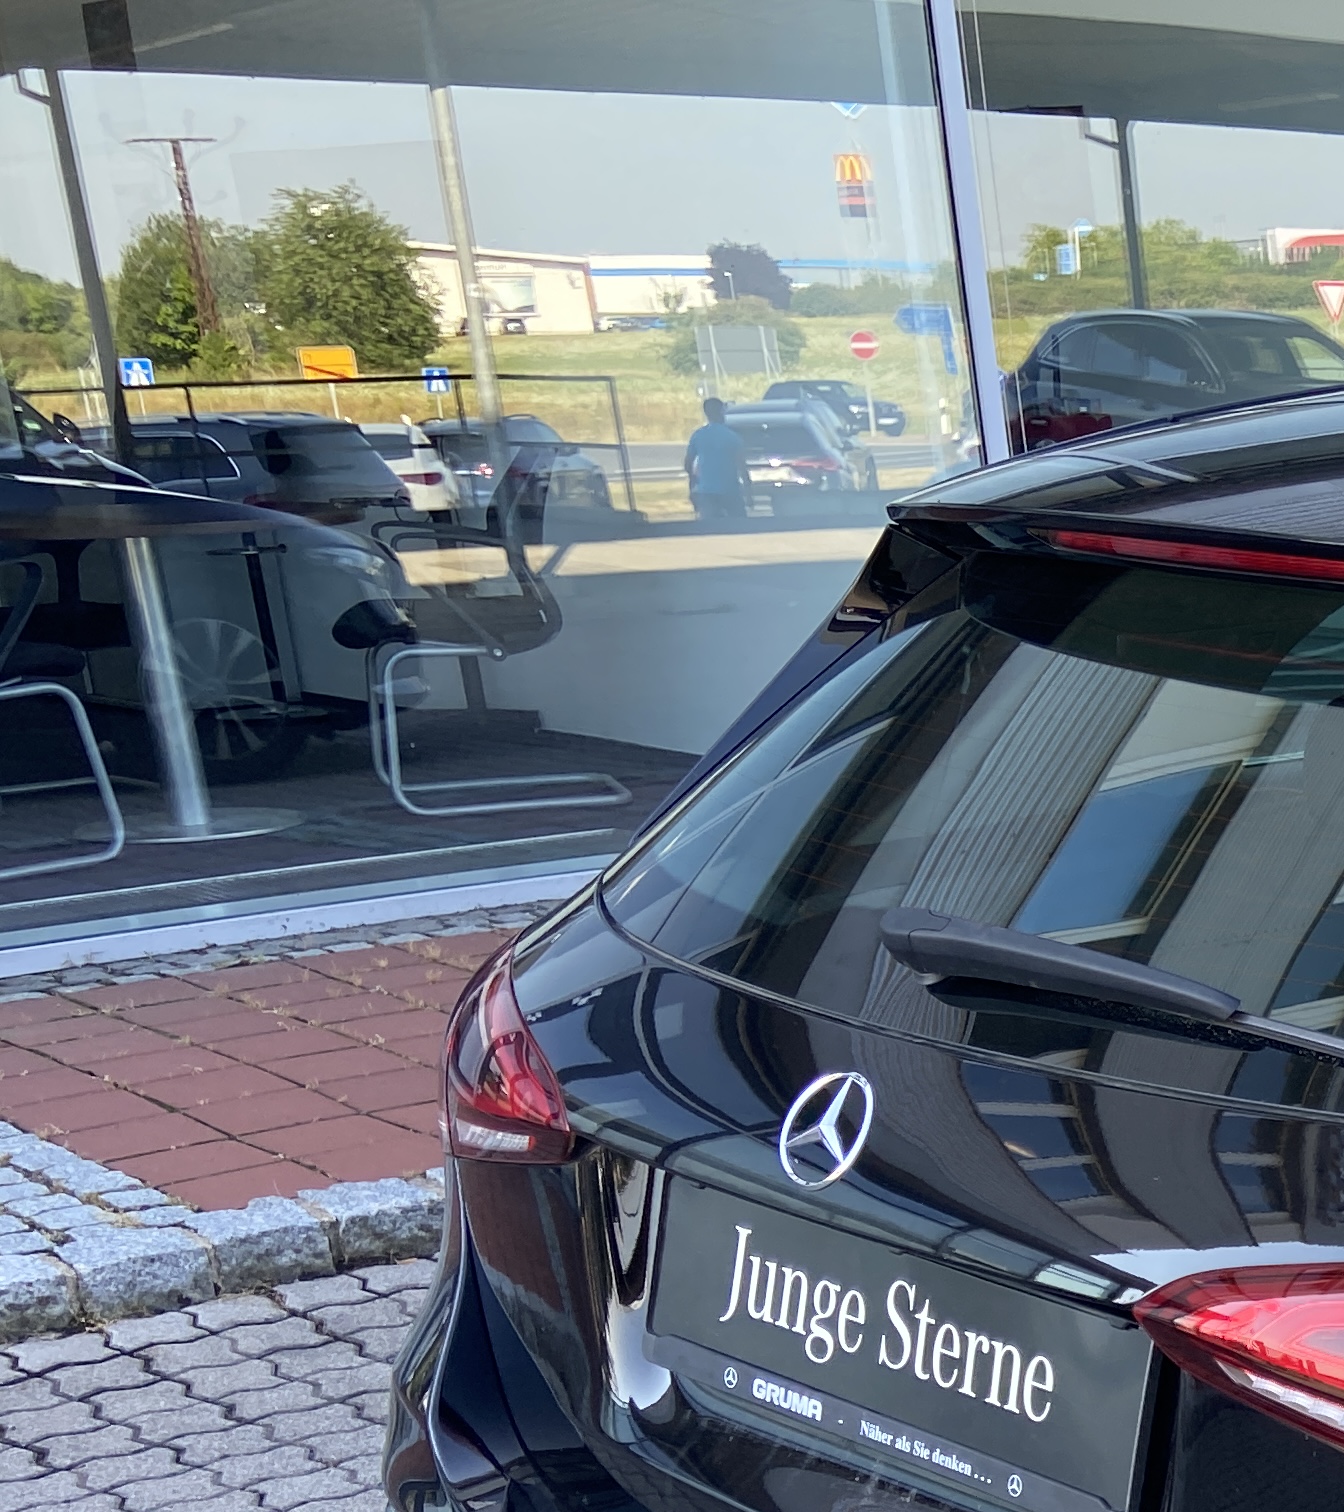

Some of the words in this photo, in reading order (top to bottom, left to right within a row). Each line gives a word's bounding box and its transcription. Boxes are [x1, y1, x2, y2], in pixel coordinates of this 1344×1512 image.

[719, 1225, 867, 1364] Junge
[877, 1279, 1055, 1422] Sterne
[752, 1378, 823, 1422] GRUMA
[859, 1419, 894, 1446] Näher
[894, 1435, 911, 1453] als
[912, 1440, 930, 1461] Sie
